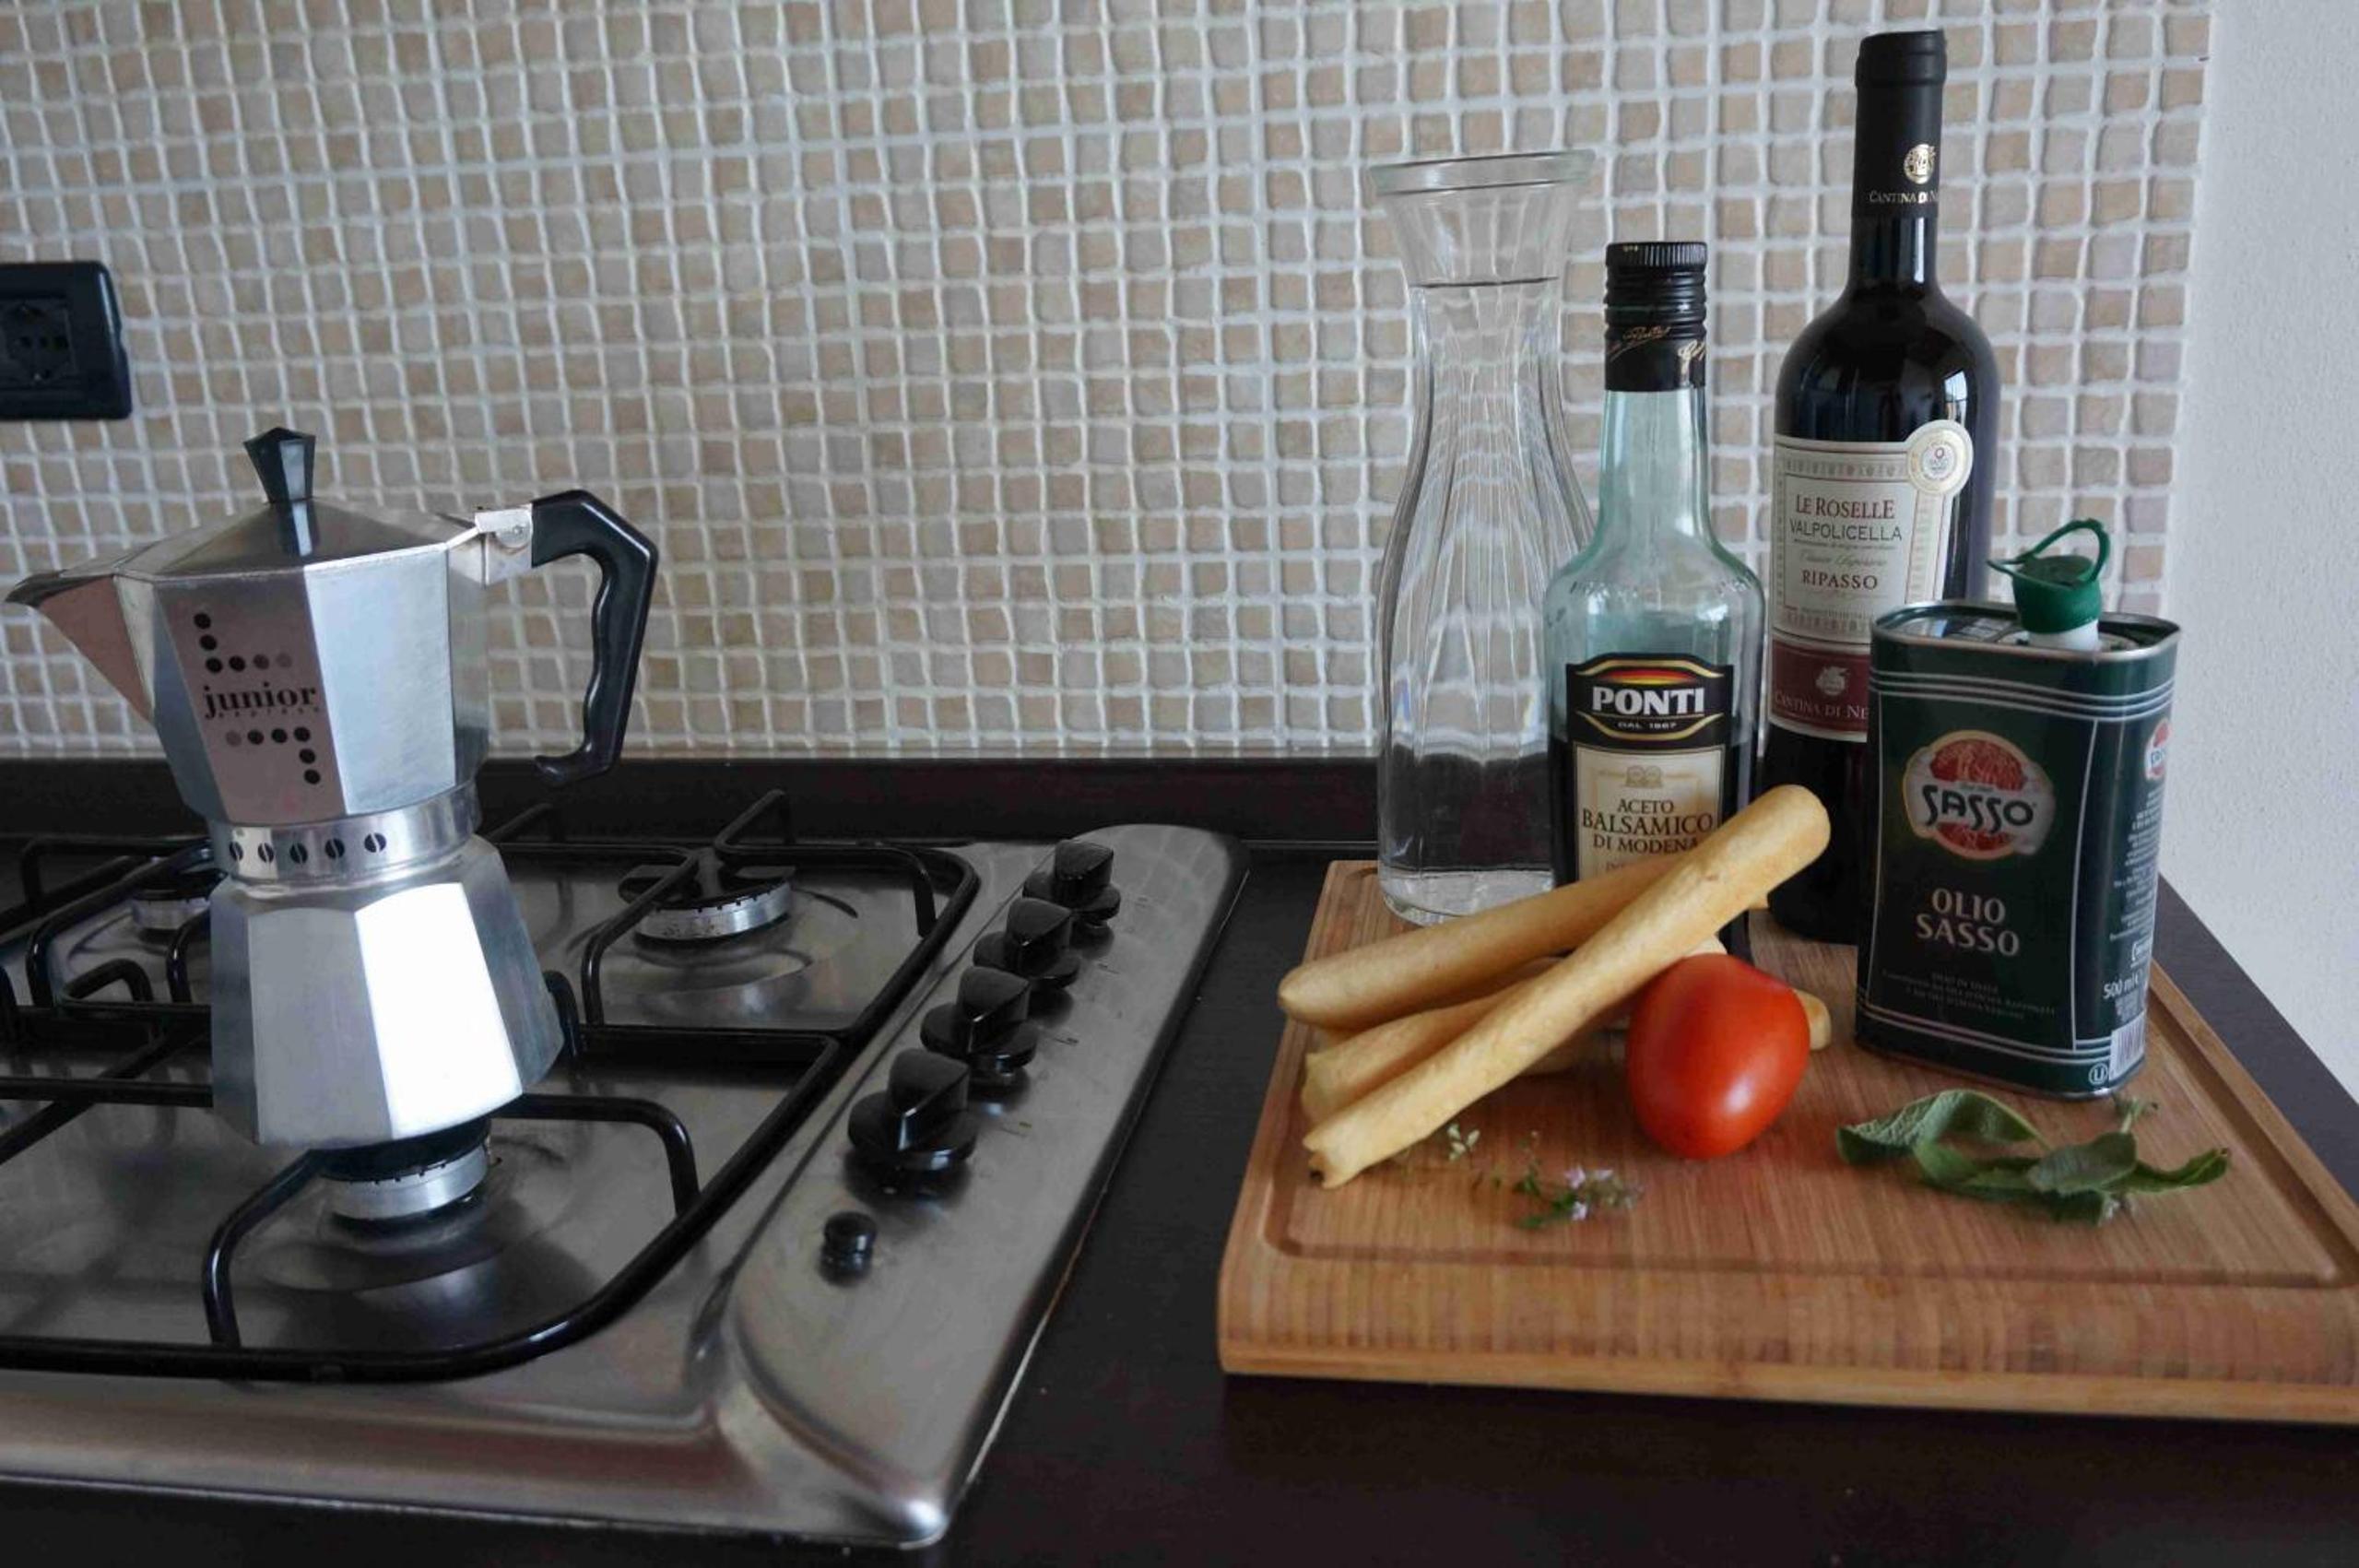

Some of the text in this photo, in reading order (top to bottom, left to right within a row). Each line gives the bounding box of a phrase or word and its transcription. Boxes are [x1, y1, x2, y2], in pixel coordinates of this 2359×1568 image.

[1814, 497, 1895, 520] ROSELLE
[1789, 519, 1903, 542] VALPOLICELLA
[1801, 570, 1879, 591] RIPASSO
[204, 681, 316, 718] junior
[1592, 687, 1705, 715] PONTI
[1825, 704, 1841, 718] DI
[1617, 799, 1674, 814] ACETO
[1922, 784, 2034, 834] SASSO
[1582, 808, 1714, 836] BALSAMICO
[1593, 833, 1611, 850] DI
[1931, 888, 2006, 924] OLIO
[1917, 913, 2020, 957] SASSO
